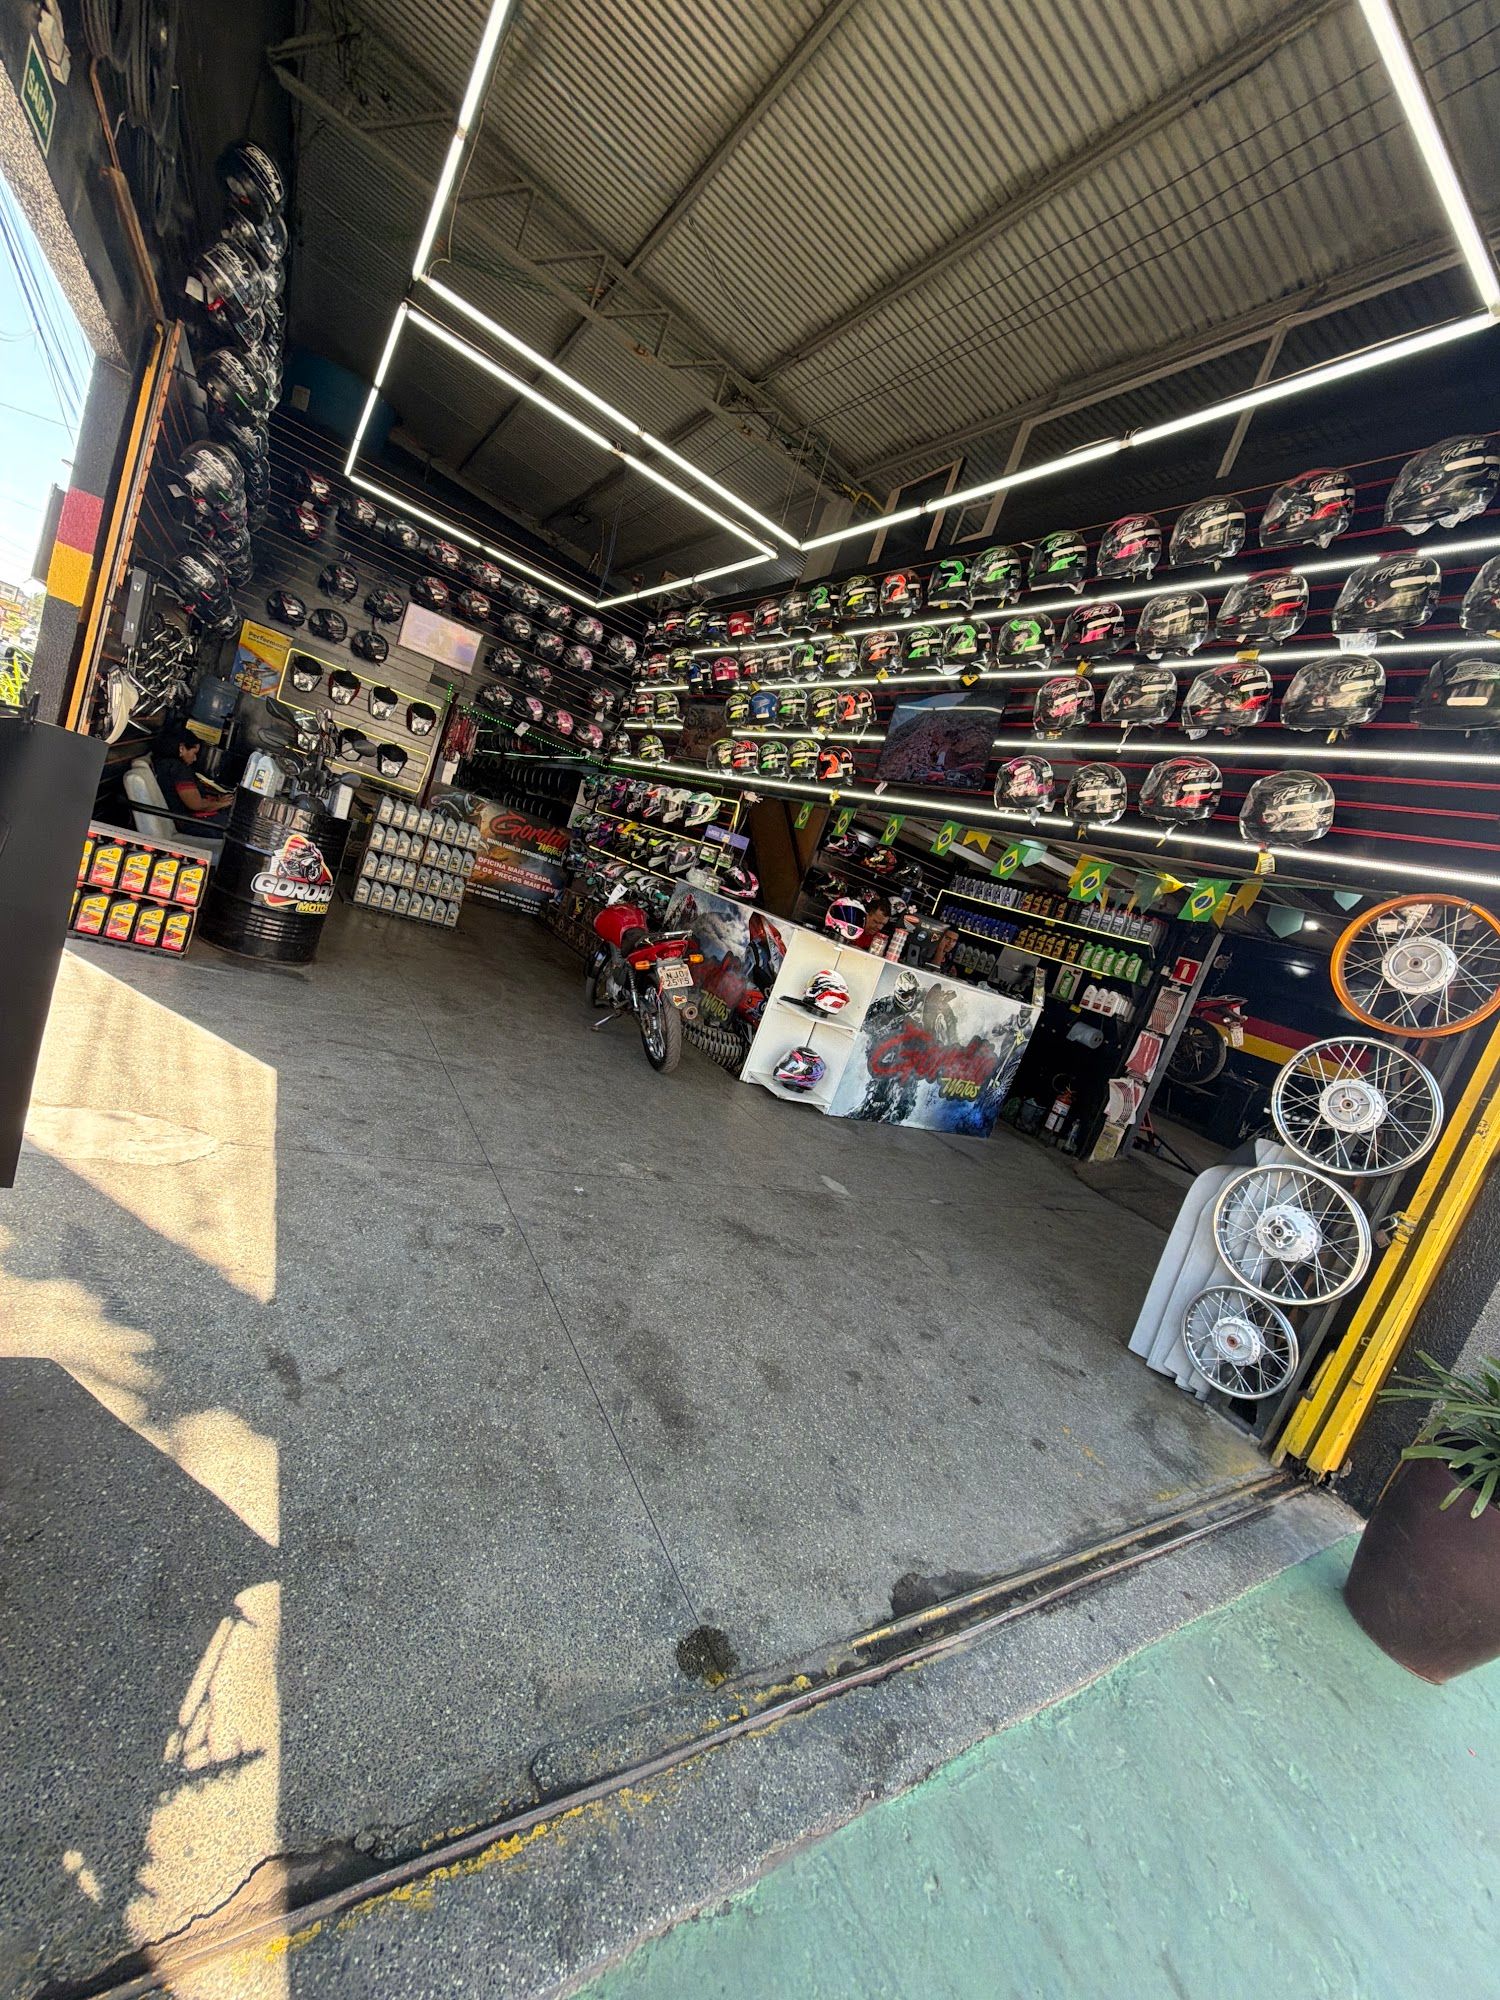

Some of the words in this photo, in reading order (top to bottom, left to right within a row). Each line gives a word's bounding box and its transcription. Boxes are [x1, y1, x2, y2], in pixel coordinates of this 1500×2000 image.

[26, 67, 50, 136] SAÍDA
[536, 841, 562, 857] Motos
[478, 856, 506, 871] OFICINA
[507, 865, 525, 876] MAIS
[483, 867, 493, 875] OS
[494, 870, 522, 884] PREÇOS
[523, 879, 541, 890] MAIS
[297, 901, 329, 913] MOTOS
[700, 988, 729, 1021] Motos
[941, 1076, 981, 1099] Motos
